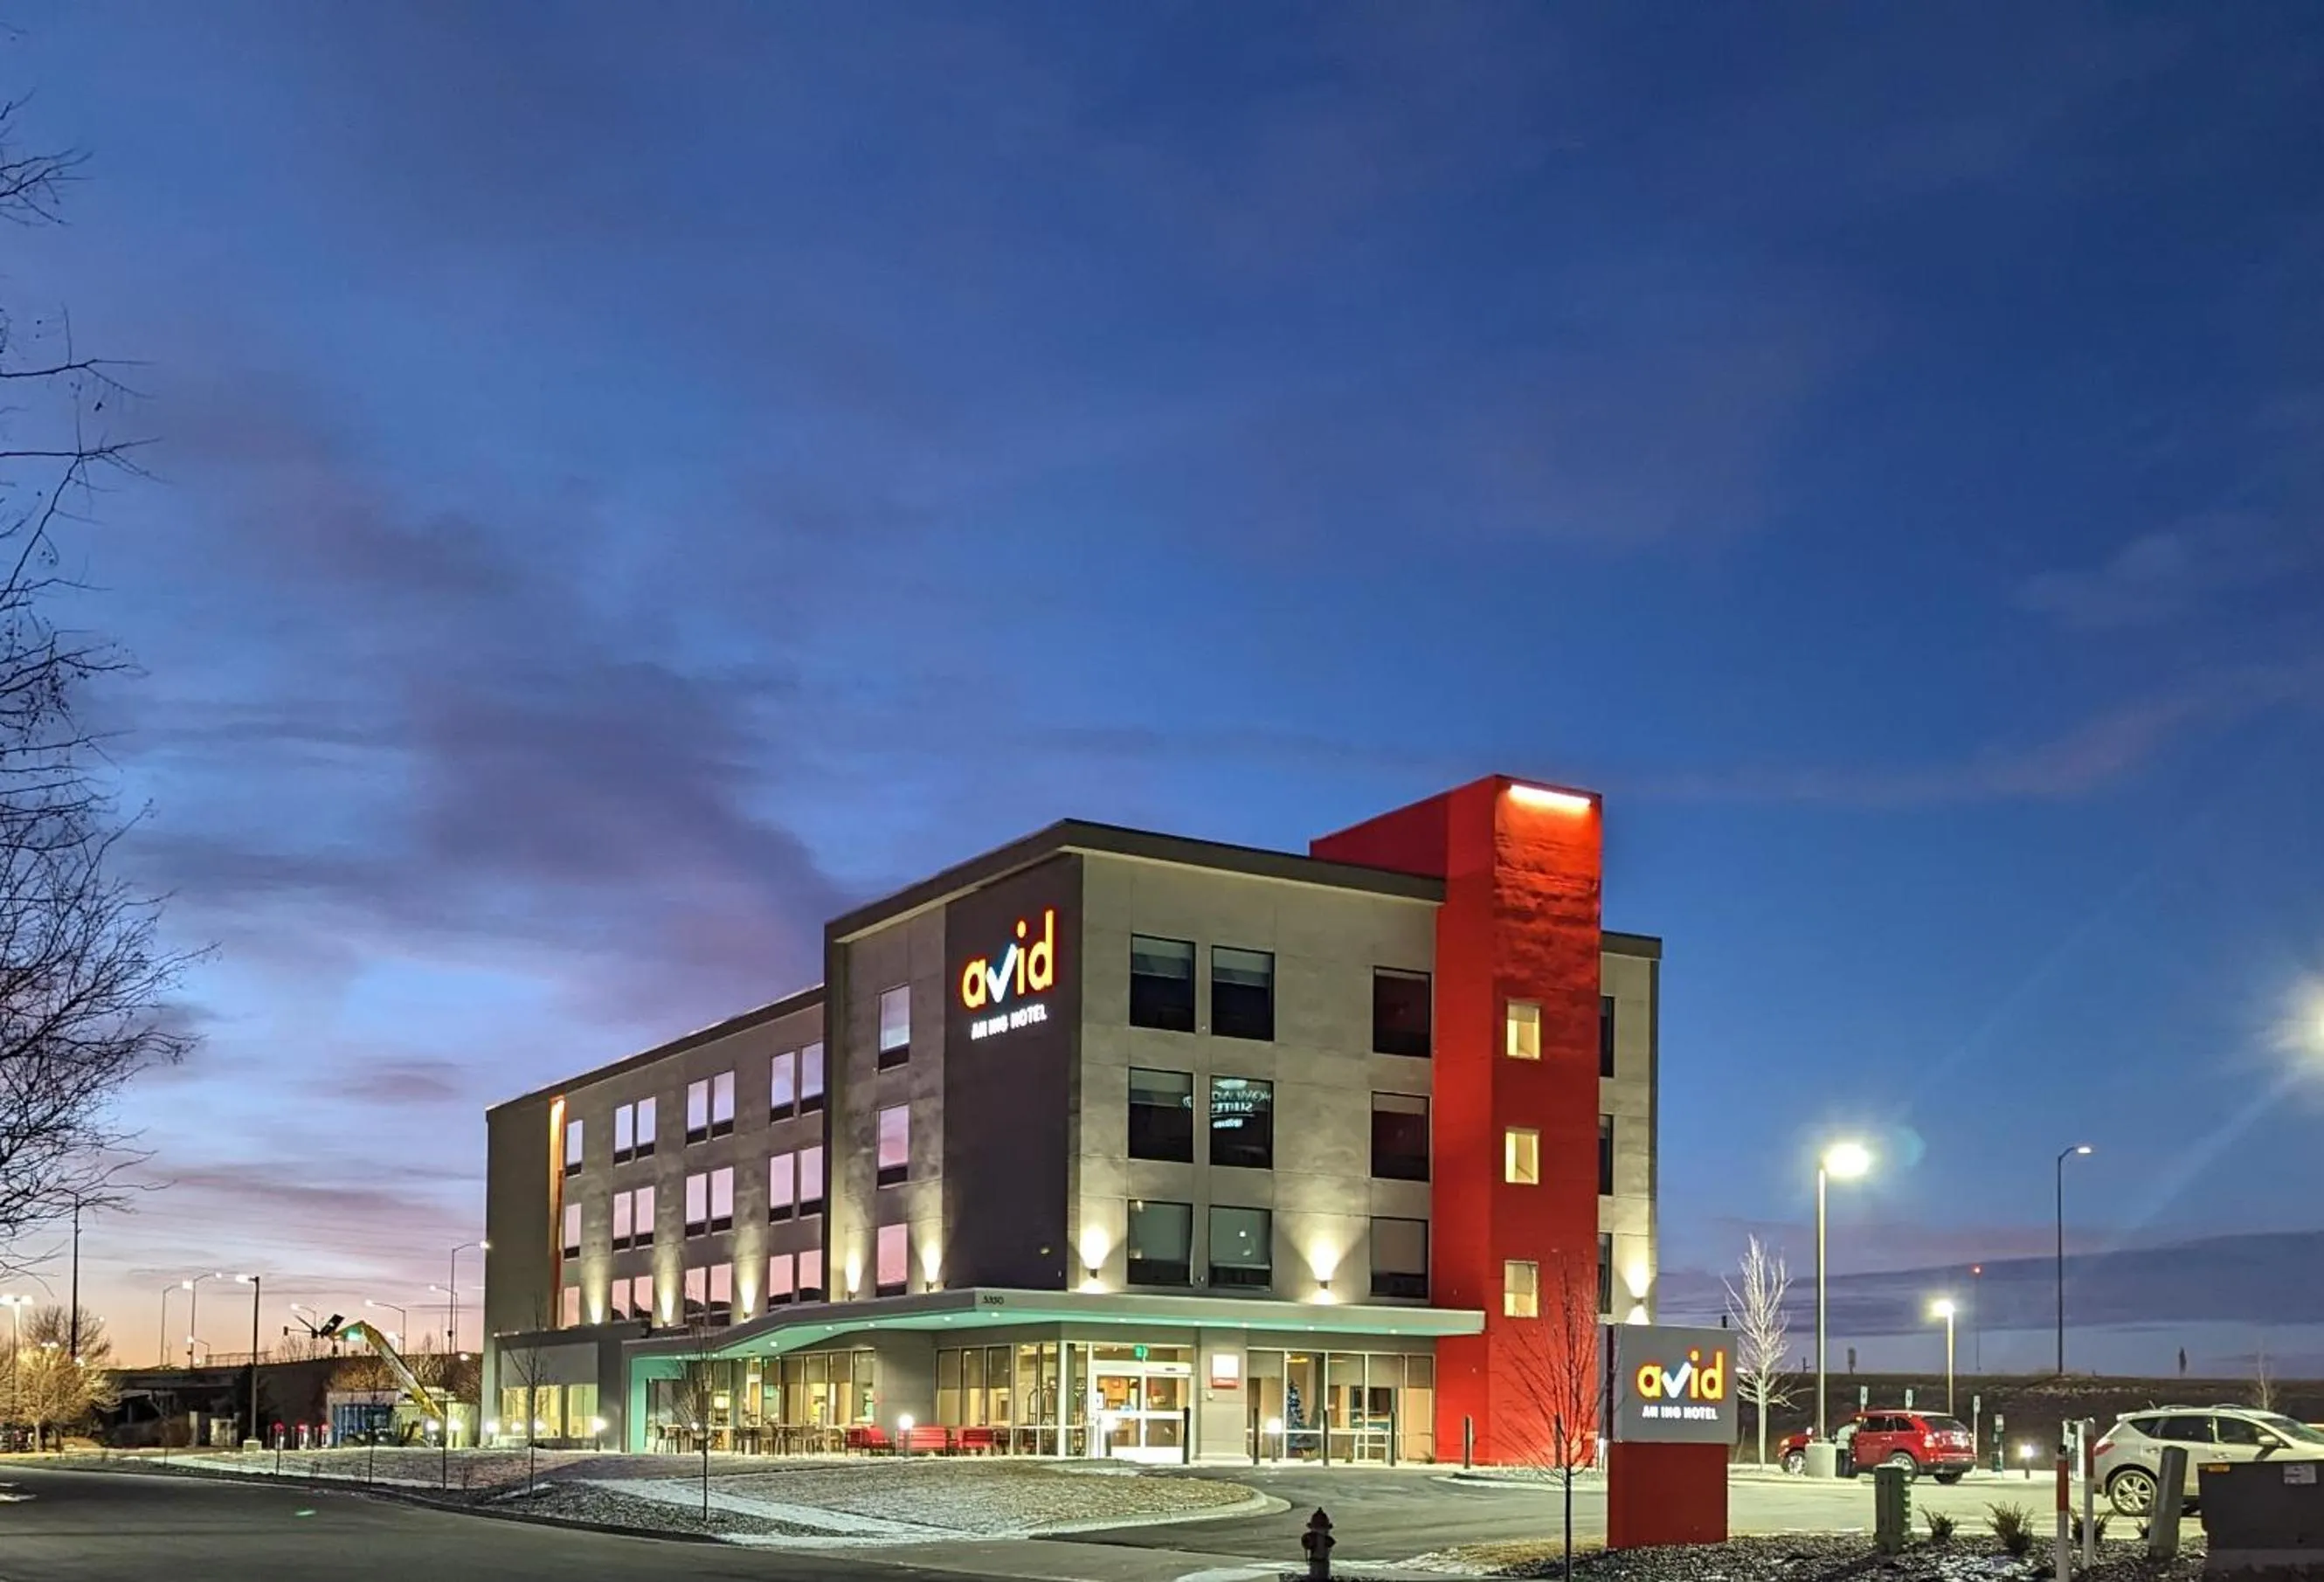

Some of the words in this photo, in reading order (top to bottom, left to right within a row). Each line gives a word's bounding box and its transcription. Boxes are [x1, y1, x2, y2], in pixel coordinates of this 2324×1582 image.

[962, 909, 1055, 1008] avid
[1010, 1004, 1048, 1029] HOTEL
[1637, 1350, 1724, 1399] avid
[1683, 1406, 1719, 1420] HOTEL
